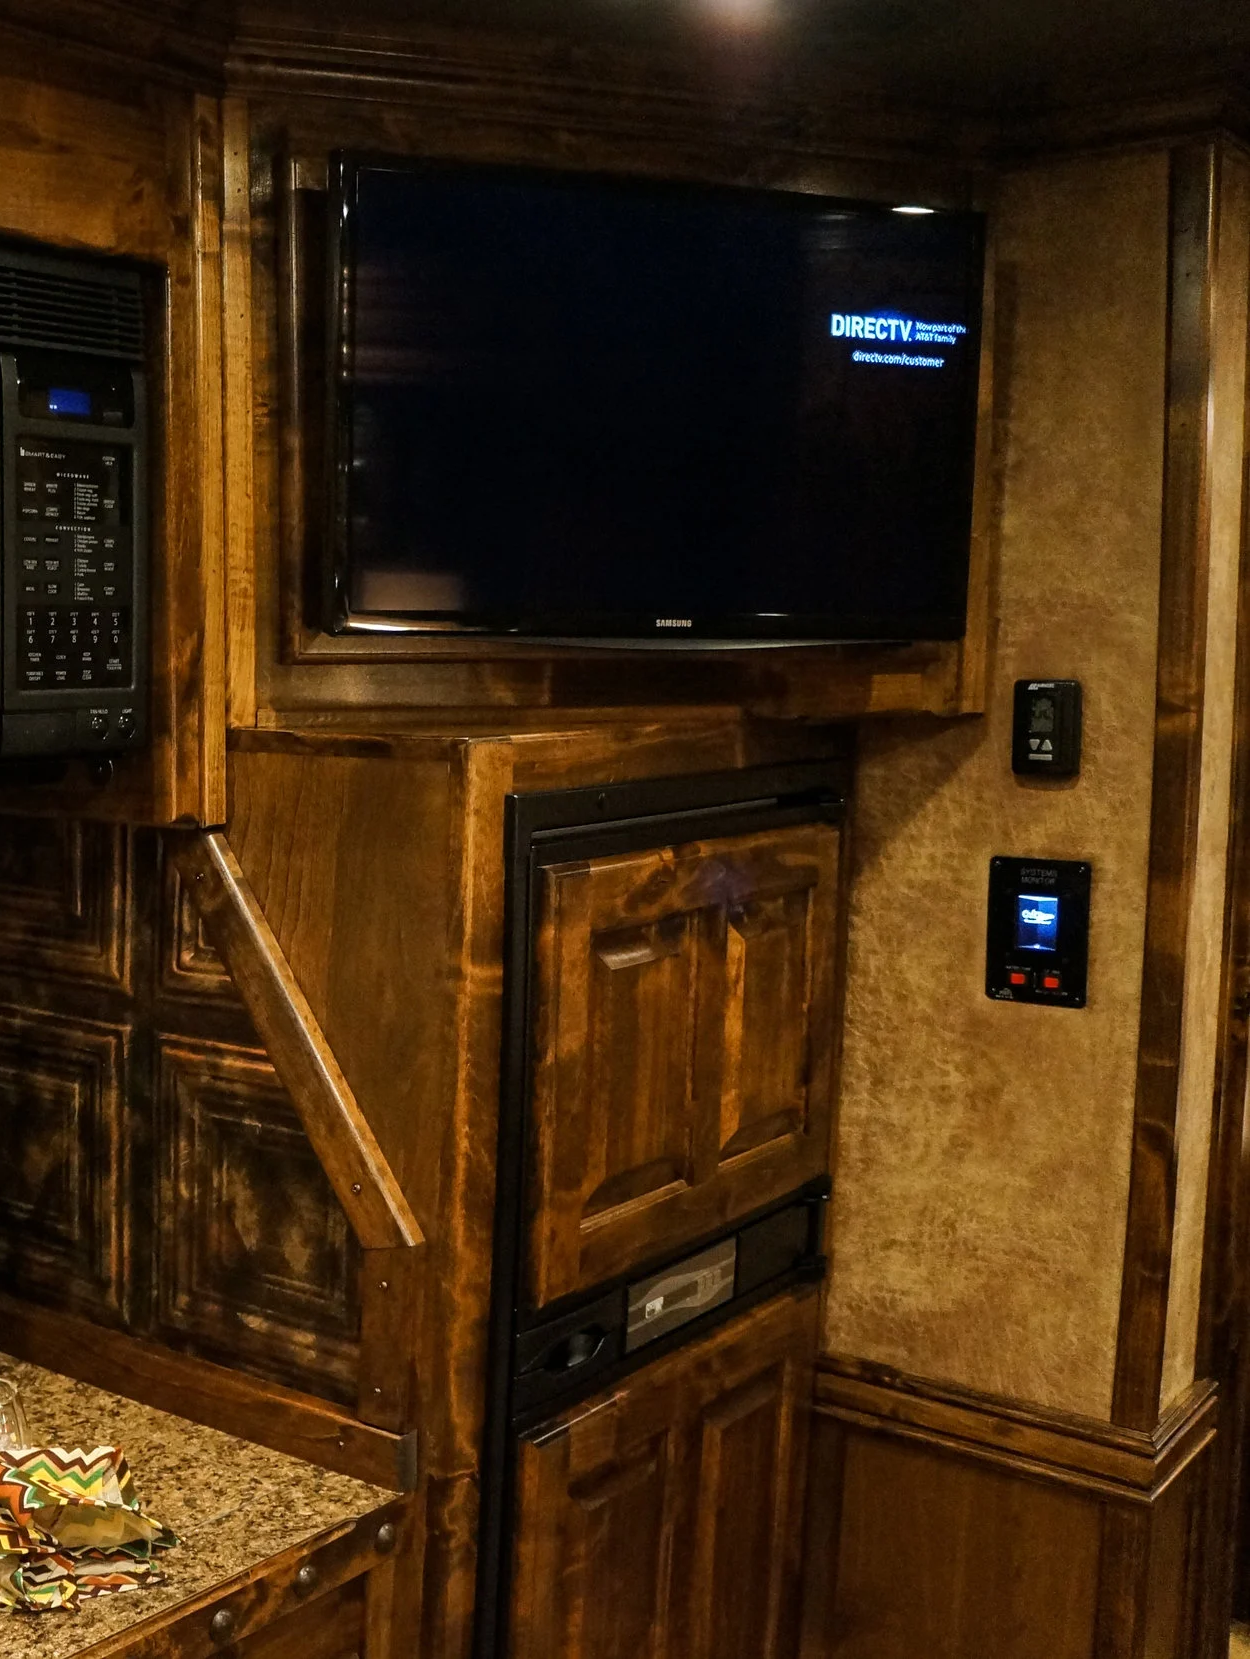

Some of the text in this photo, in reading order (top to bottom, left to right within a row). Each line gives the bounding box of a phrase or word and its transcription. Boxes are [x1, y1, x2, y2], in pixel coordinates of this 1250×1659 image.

[915, 321, 932, 331] Now
[932, 323, 947, 333] part
[915, 332, 957, 345] AT&T family
[852, 349, 945, 368] directv.com/customer
[28, 617, 33, 626] 1
[50, 617, 55, 626] 2
[72, 617, 77, 626] 3
[93, 617, 98, 626] 4
[113, 617, 118, 626] 5
[655, 619, 692, 628] SAMSUNG
[28, 635, 33, 644] 6
[50, 635, 55, 644] 7
[72, 635, 77, 644] 8
[93, 635, 98, 644] 9
[113, 635, 118, 644] 0
